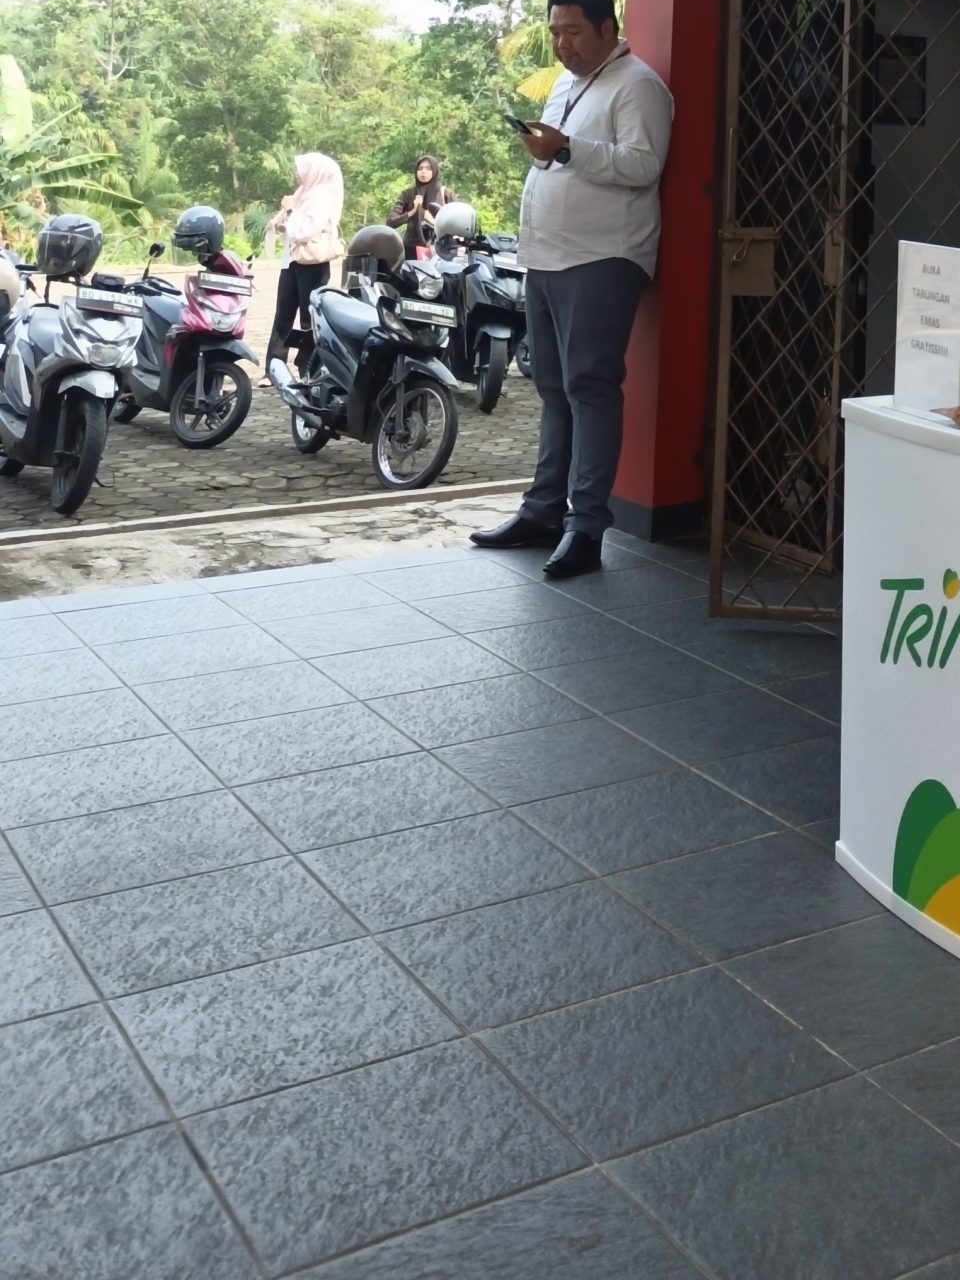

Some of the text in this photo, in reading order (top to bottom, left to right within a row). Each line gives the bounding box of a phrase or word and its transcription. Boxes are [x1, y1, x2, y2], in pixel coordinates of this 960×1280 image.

[922, 263, 941, 276] BUKA
[912, 286, 950, 305] TABUNGAN
[920, 314, 941, 329] EMAS
